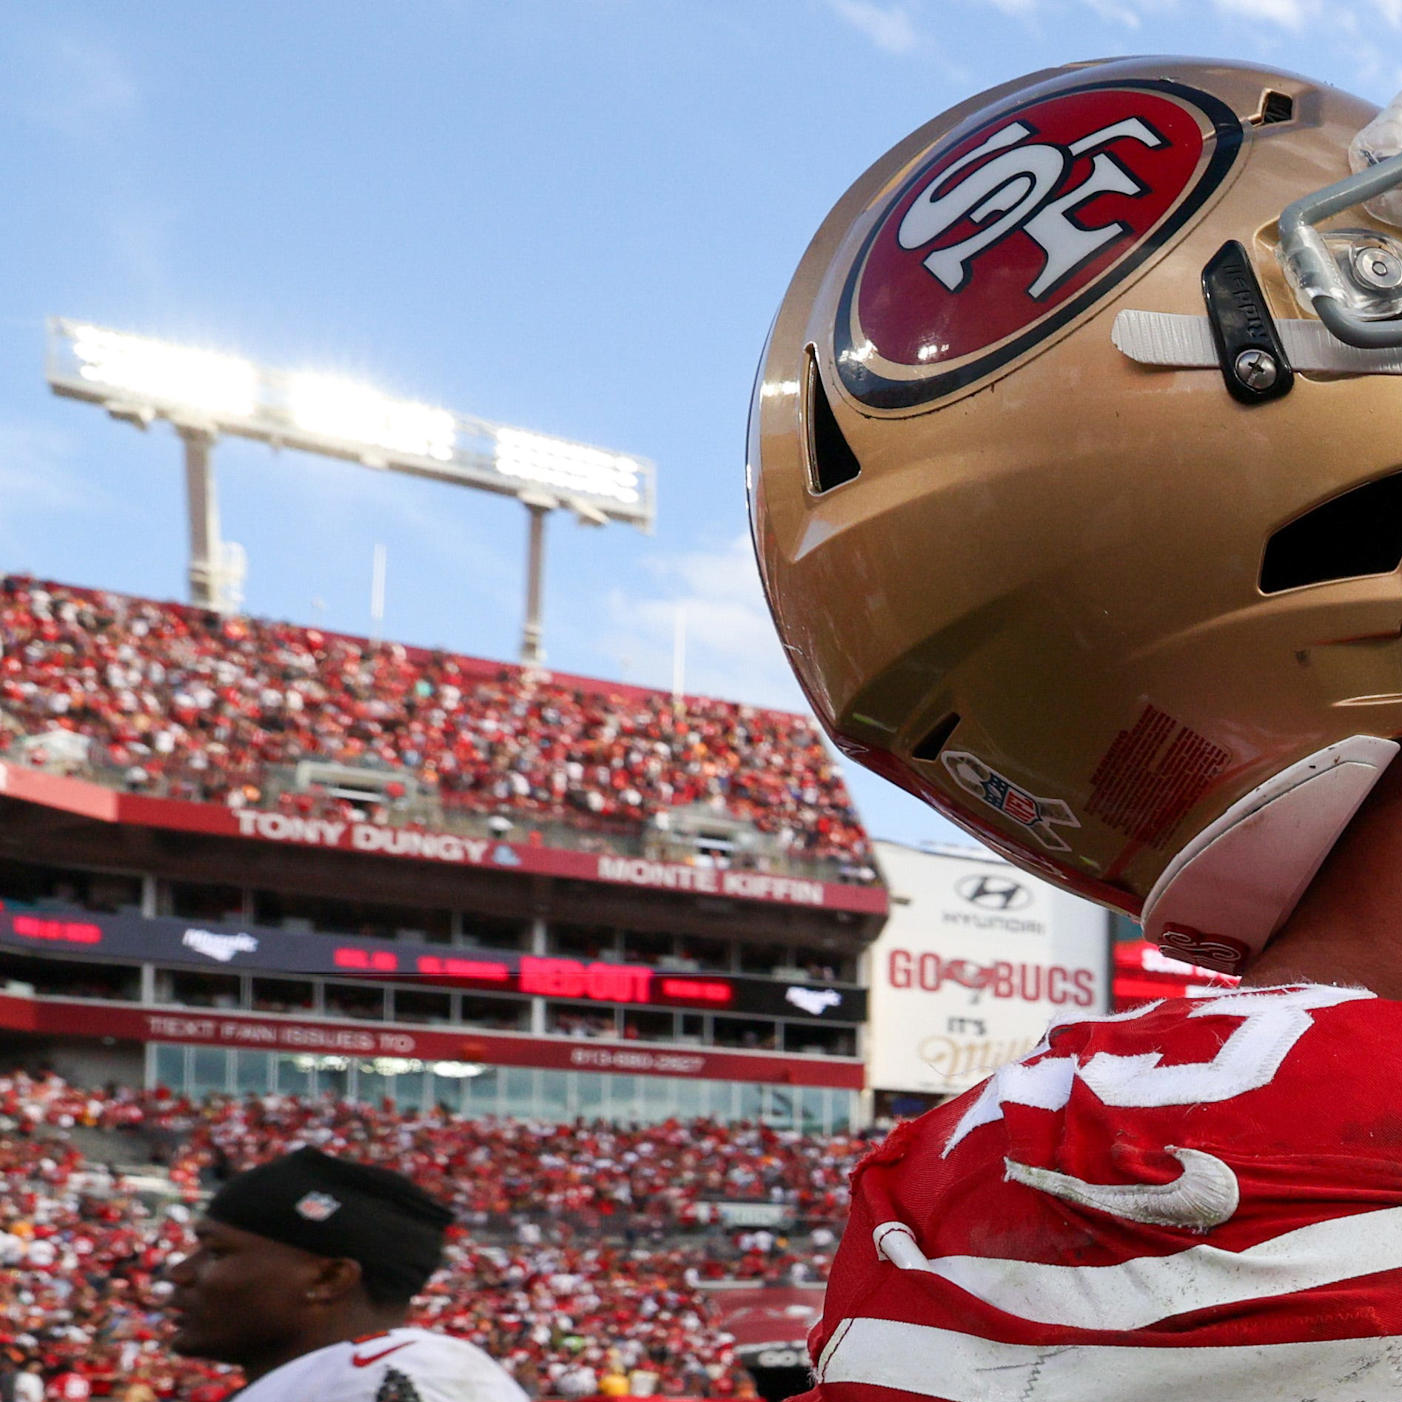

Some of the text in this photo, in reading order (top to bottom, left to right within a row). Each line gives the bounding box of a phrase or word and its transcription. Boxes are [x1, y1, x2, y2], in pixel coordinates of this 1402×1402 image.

[231, 809, 491, 864] TONY DUNGY
[598, 856, 825, 905] MONTE KIFFIN
[888, 947, 943, 993] GO
[993, 960, 1095, 1008] BUCS
[149, 1015, 216, 1038] TEXT
